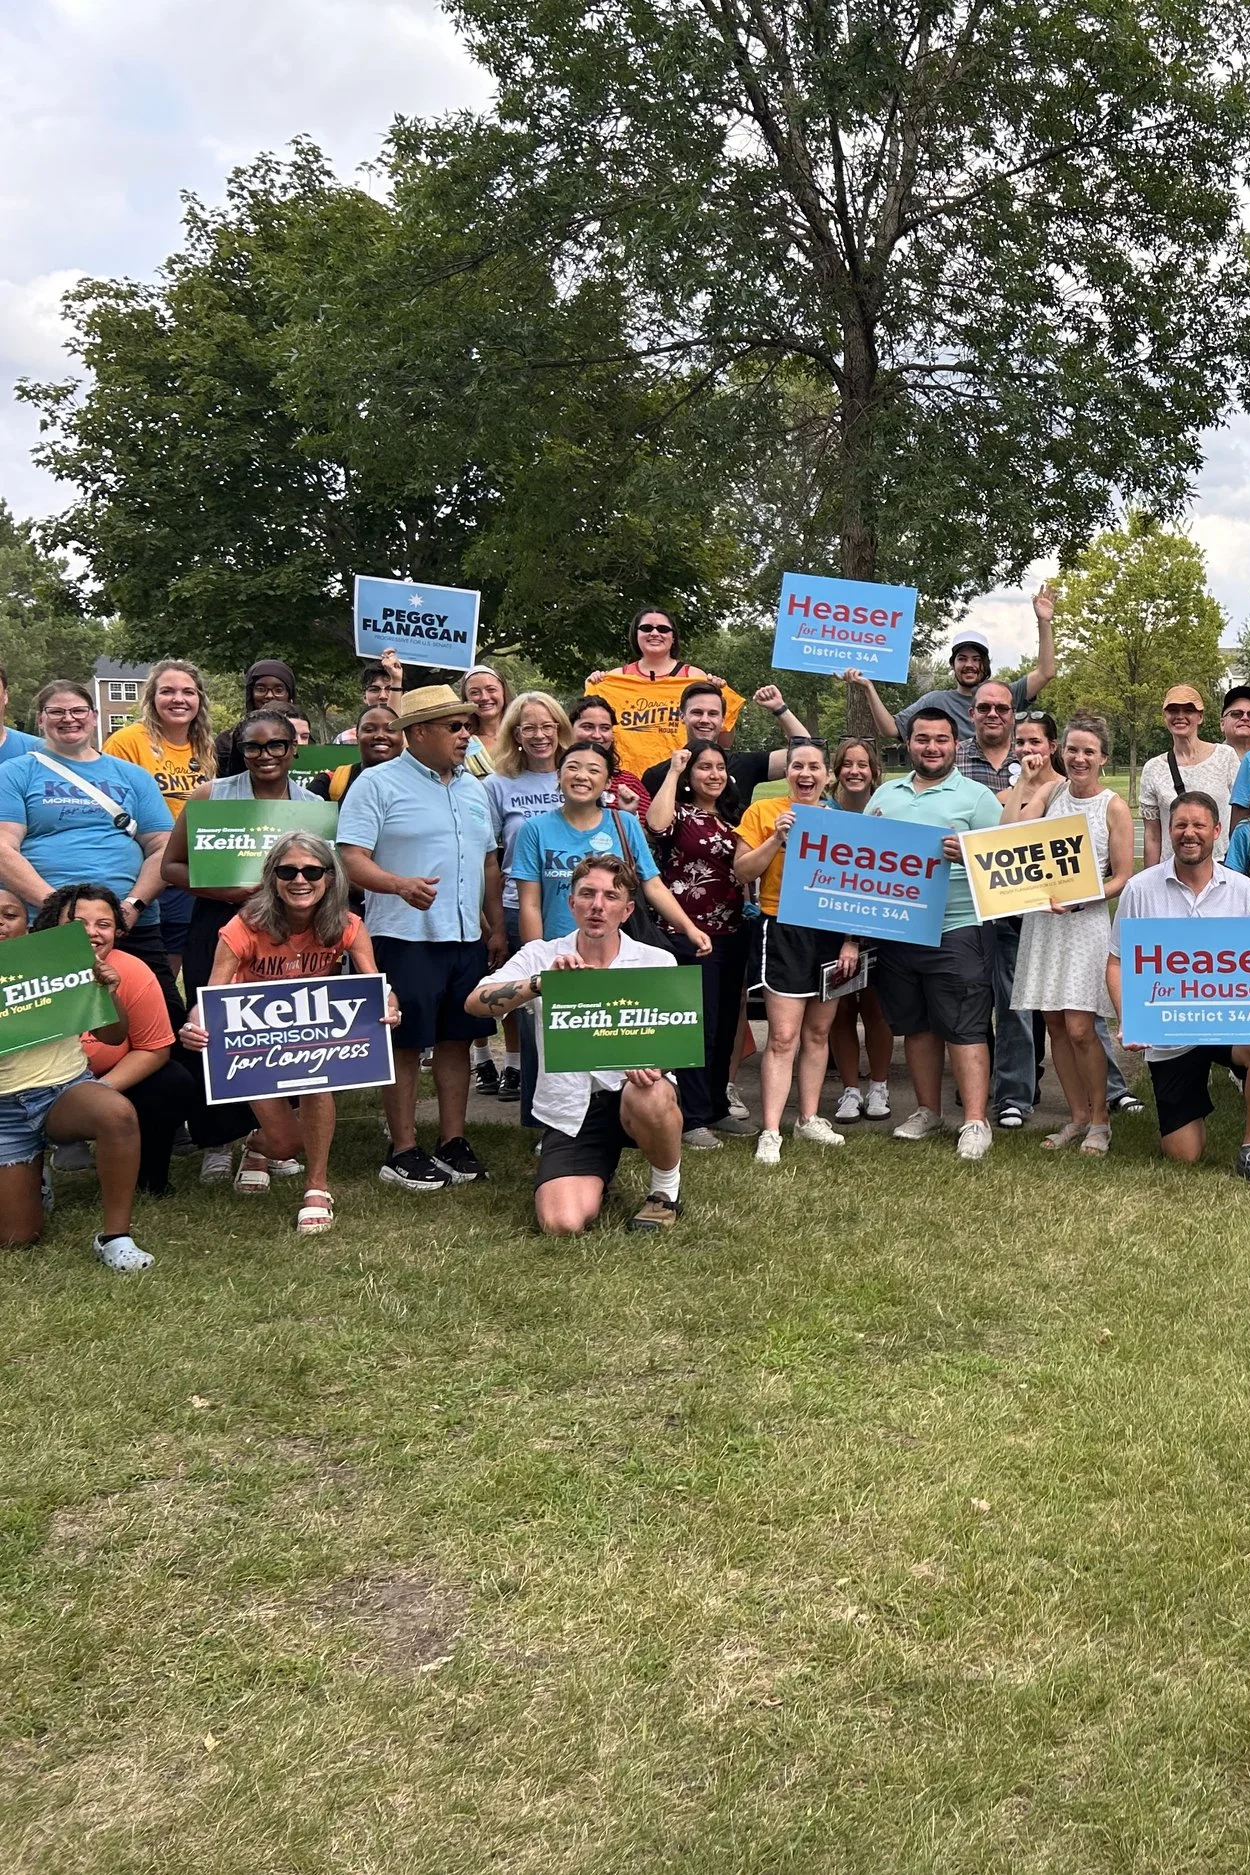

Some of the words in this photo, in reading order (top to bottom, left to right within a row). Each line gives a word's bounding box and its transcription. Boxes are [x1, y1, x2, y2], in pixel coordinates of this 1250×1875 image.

[382, 607, 449, 628] PEGGY
[787, 593, 904, 628] Heaser
[362, 618, 467, 644] FLANAGAN
[797, 622, 818, 638] for
[821, 624, 887, 645] House
[803, 645, 852, 660] District
[855, 651, 879, 663] 34A
[620, 706, 680, 726] SMITH
[42, 797, 101, 806] MORRISO
[194, 833, 257, 850] Keith
[974, 843, 1046, 871] VOTE
[1049, 834, 1084, 859] BY
[237, 850, 262, 858] Afford
[799, 831, 941, 879] Heaser
[989, 863, 1054, 889] AUG.
[1055, 855, 1081, 877] 11
[809, 868, 836, 888] for
[839, 871, 921, 900] House
[818, 897, 878, 917] District
[881, 907, 910, 921] 34A
[3, 968, 95, 1006] Ellison
[1150, 981, 1175, 1003] for
[11, 1003, 32, 1014] Your
[34, 997, 52, 1008] Life
[220, 985, 367, 1038] Kelly
[1161, 1010, 1224, 1022] District
[549, 1009, 613, 1029] Keith
[617, 1008, 698, 1027] Ellison
[224, 1027, 328, 1049] MORRISON
[592, 1028, 619, 1037] Afford
[620, 1028, 639, 1036] Your
[640, 1027, 656, 1035] Life
[226, 1055, 263, 1080] for
[265, 1042, 370, 1073] Congress
